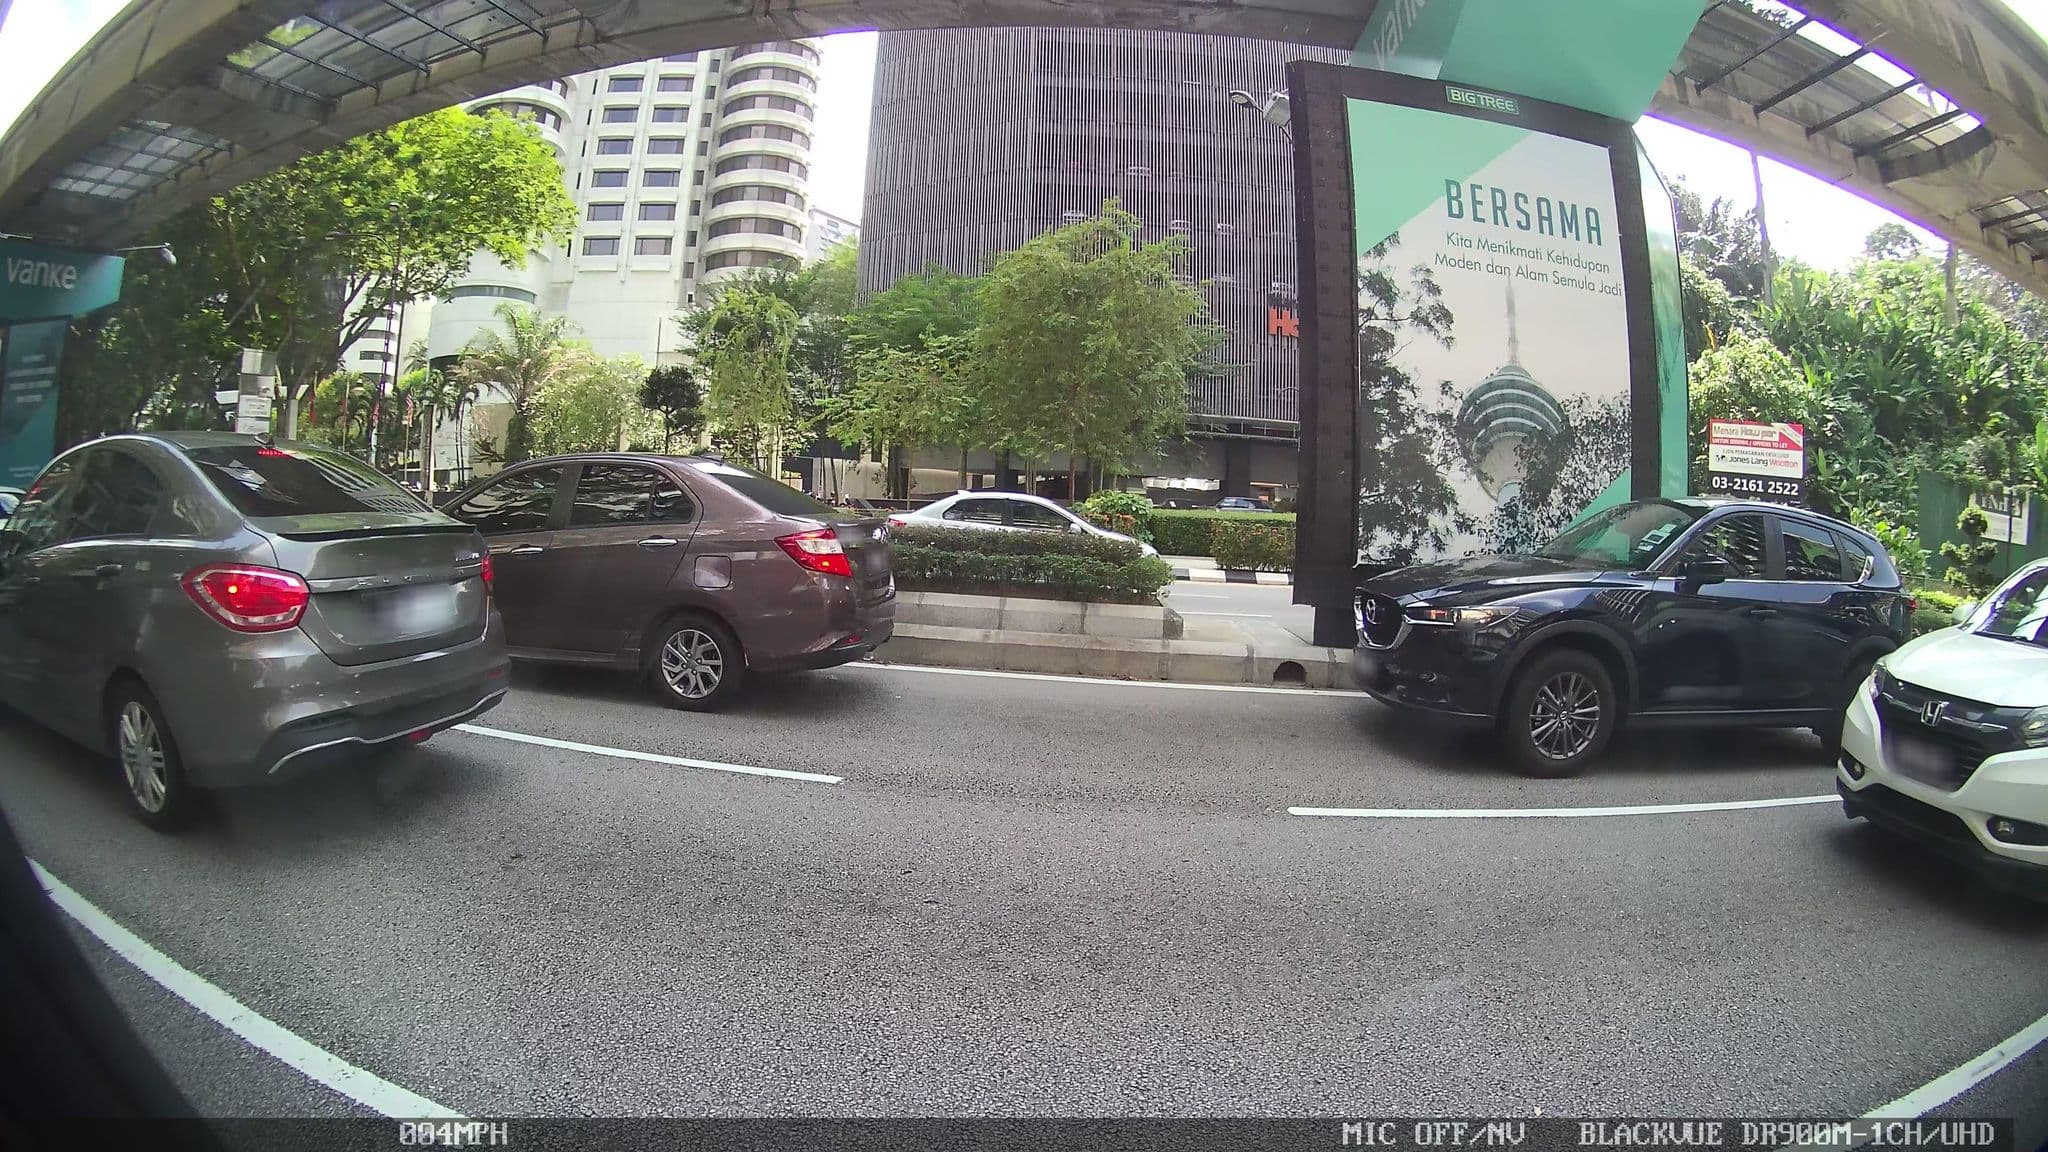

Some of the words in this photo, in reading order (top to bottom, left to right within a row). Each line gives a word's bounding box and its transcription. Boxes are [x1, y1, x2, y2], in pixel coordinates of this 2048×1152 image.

[1451, 89, 1476, 104] BIG
[1477, 95, 1515, 112] TREE
[1445, 179, 1602, 246] BERSAMA
[1446, 232, 1473, 249] Kita
[1476, 237, 1543, 261] Menikmati
[1547, 250, 1610, 274] Kehidupan
[7, 257, 77, 290] vanke
[1435, 253, 1482, 272] Moden
[1486, 258, 1511, 276] dan
[1515, 265, 1549, 283] Alam
[1552, 271, 1596, 292] Semula
[1599, 280, 1622, 297] Jadi
[1751, 458, 1769, 467] Lang
[1712, 477, 1764, 493] 03-2161
[1767, 481, 1799, 496] 2522
